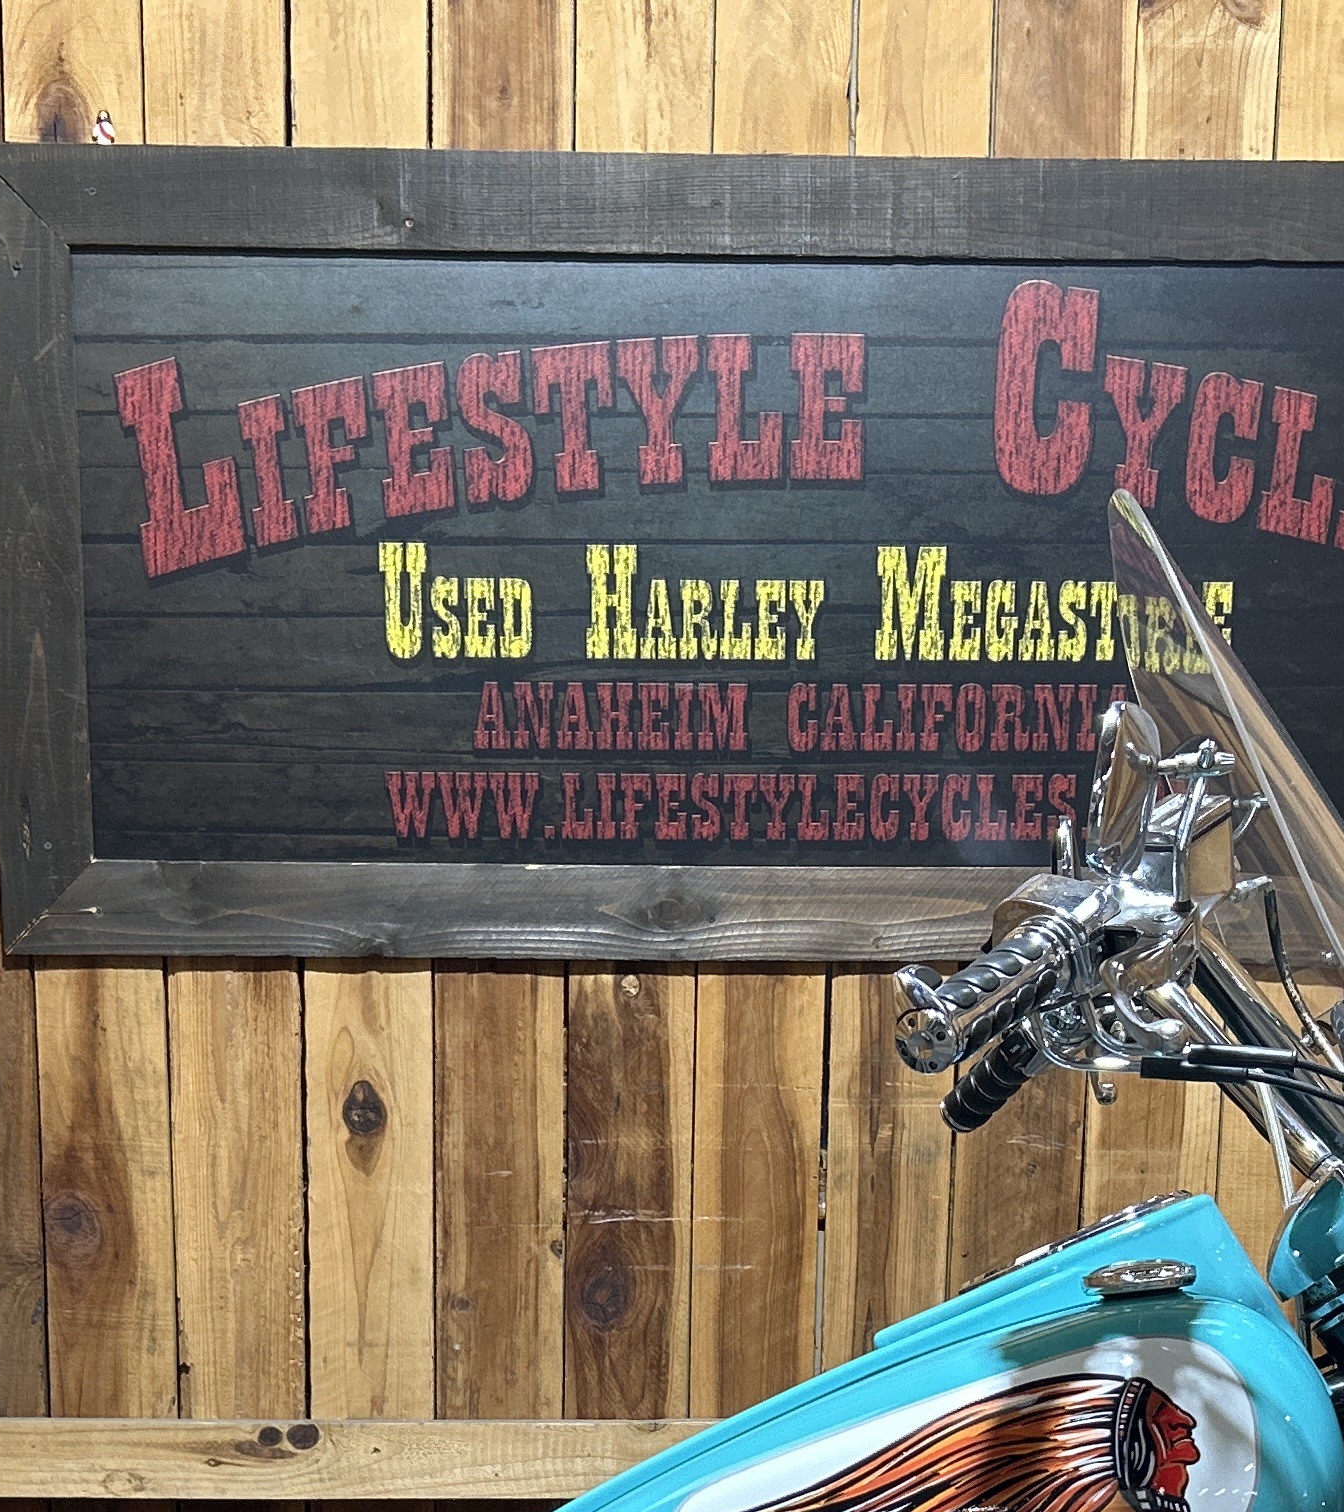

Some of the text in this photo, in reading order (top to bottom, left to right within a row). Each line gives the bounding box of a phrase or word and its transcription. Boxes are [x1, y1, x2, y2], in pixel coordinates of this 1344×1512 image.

[114, 332, 865, 578] LIFESTYLE
[378, 541, 533, 659] USED
[585, 543, 825, 661] HARLEY
[472, 680, 749, 752] ANAHEIM
